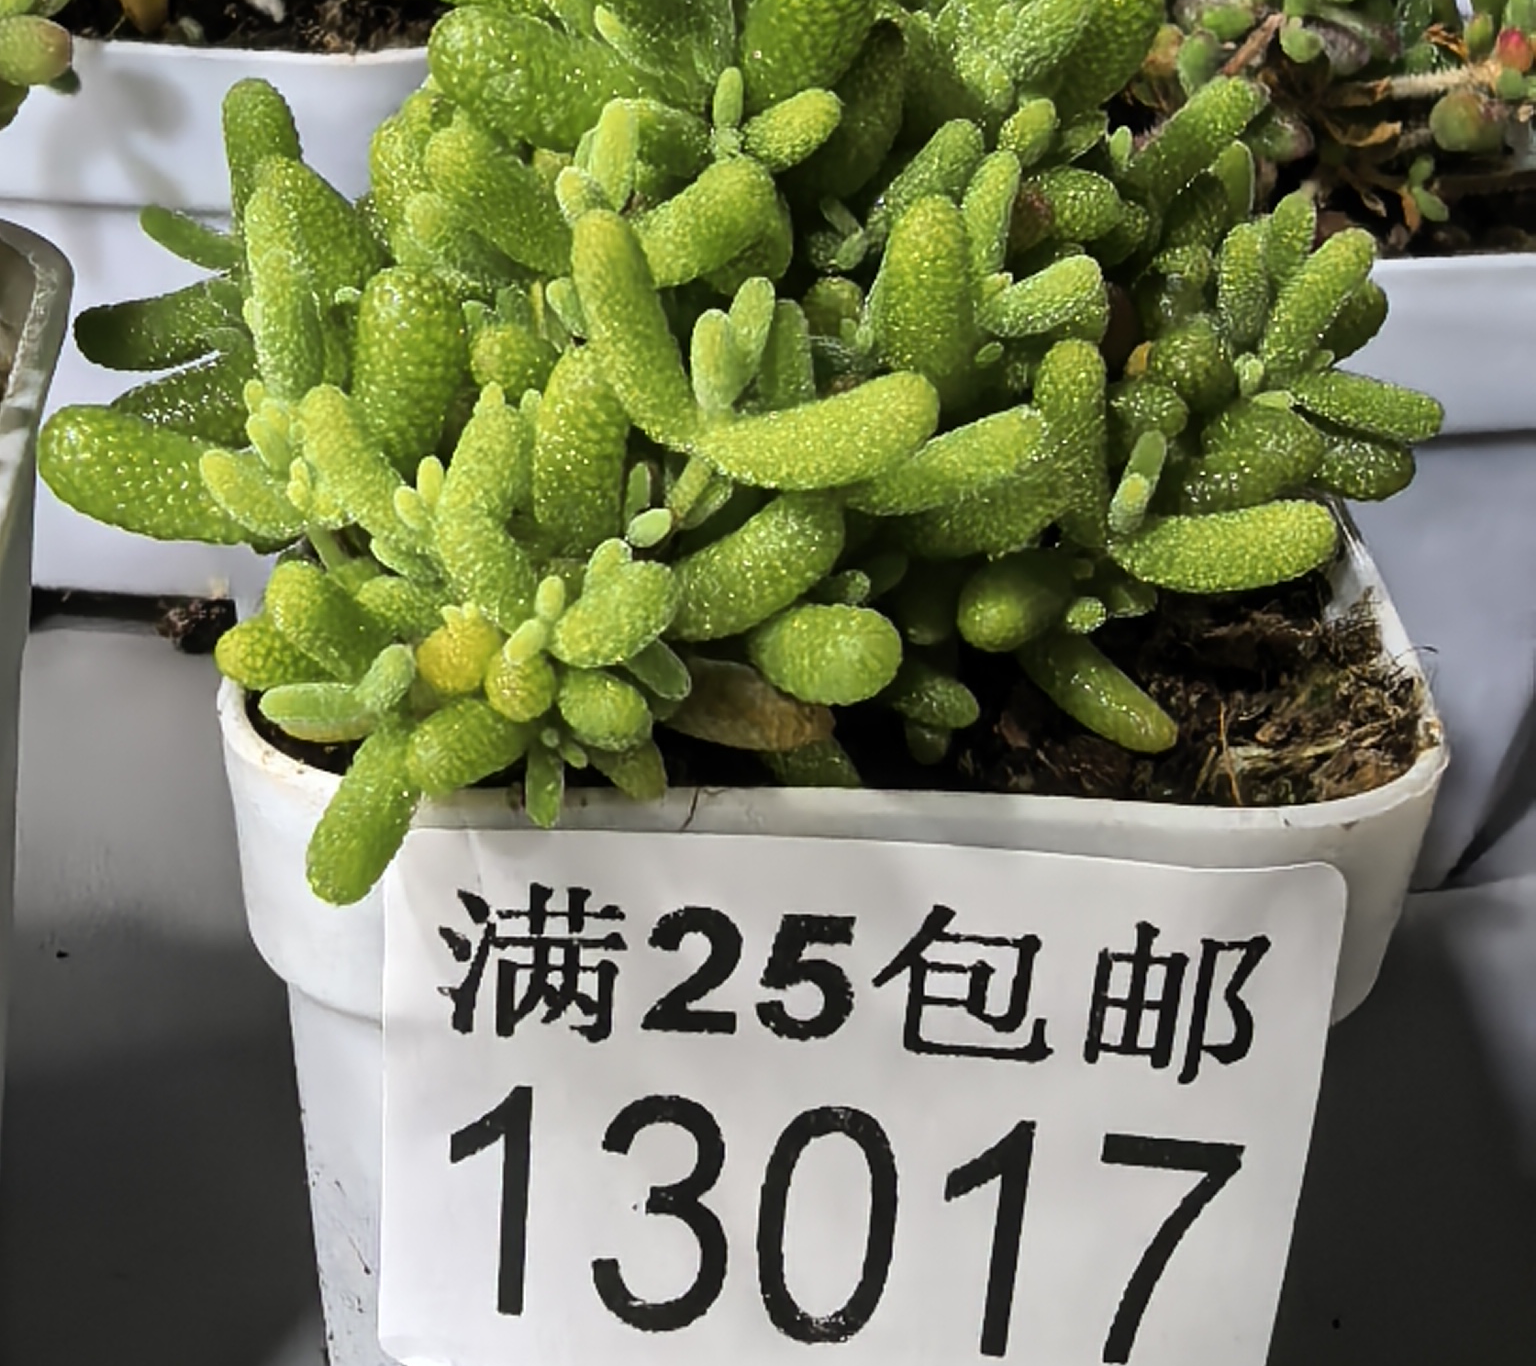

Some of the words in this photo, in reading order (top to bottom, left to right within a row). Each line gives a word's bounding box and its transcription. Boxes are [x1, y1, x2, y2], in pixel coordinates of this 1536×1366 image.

[438, 882, 1272, 1085] 满25包邮
[450, 1085, 1246, 1366] 13017
